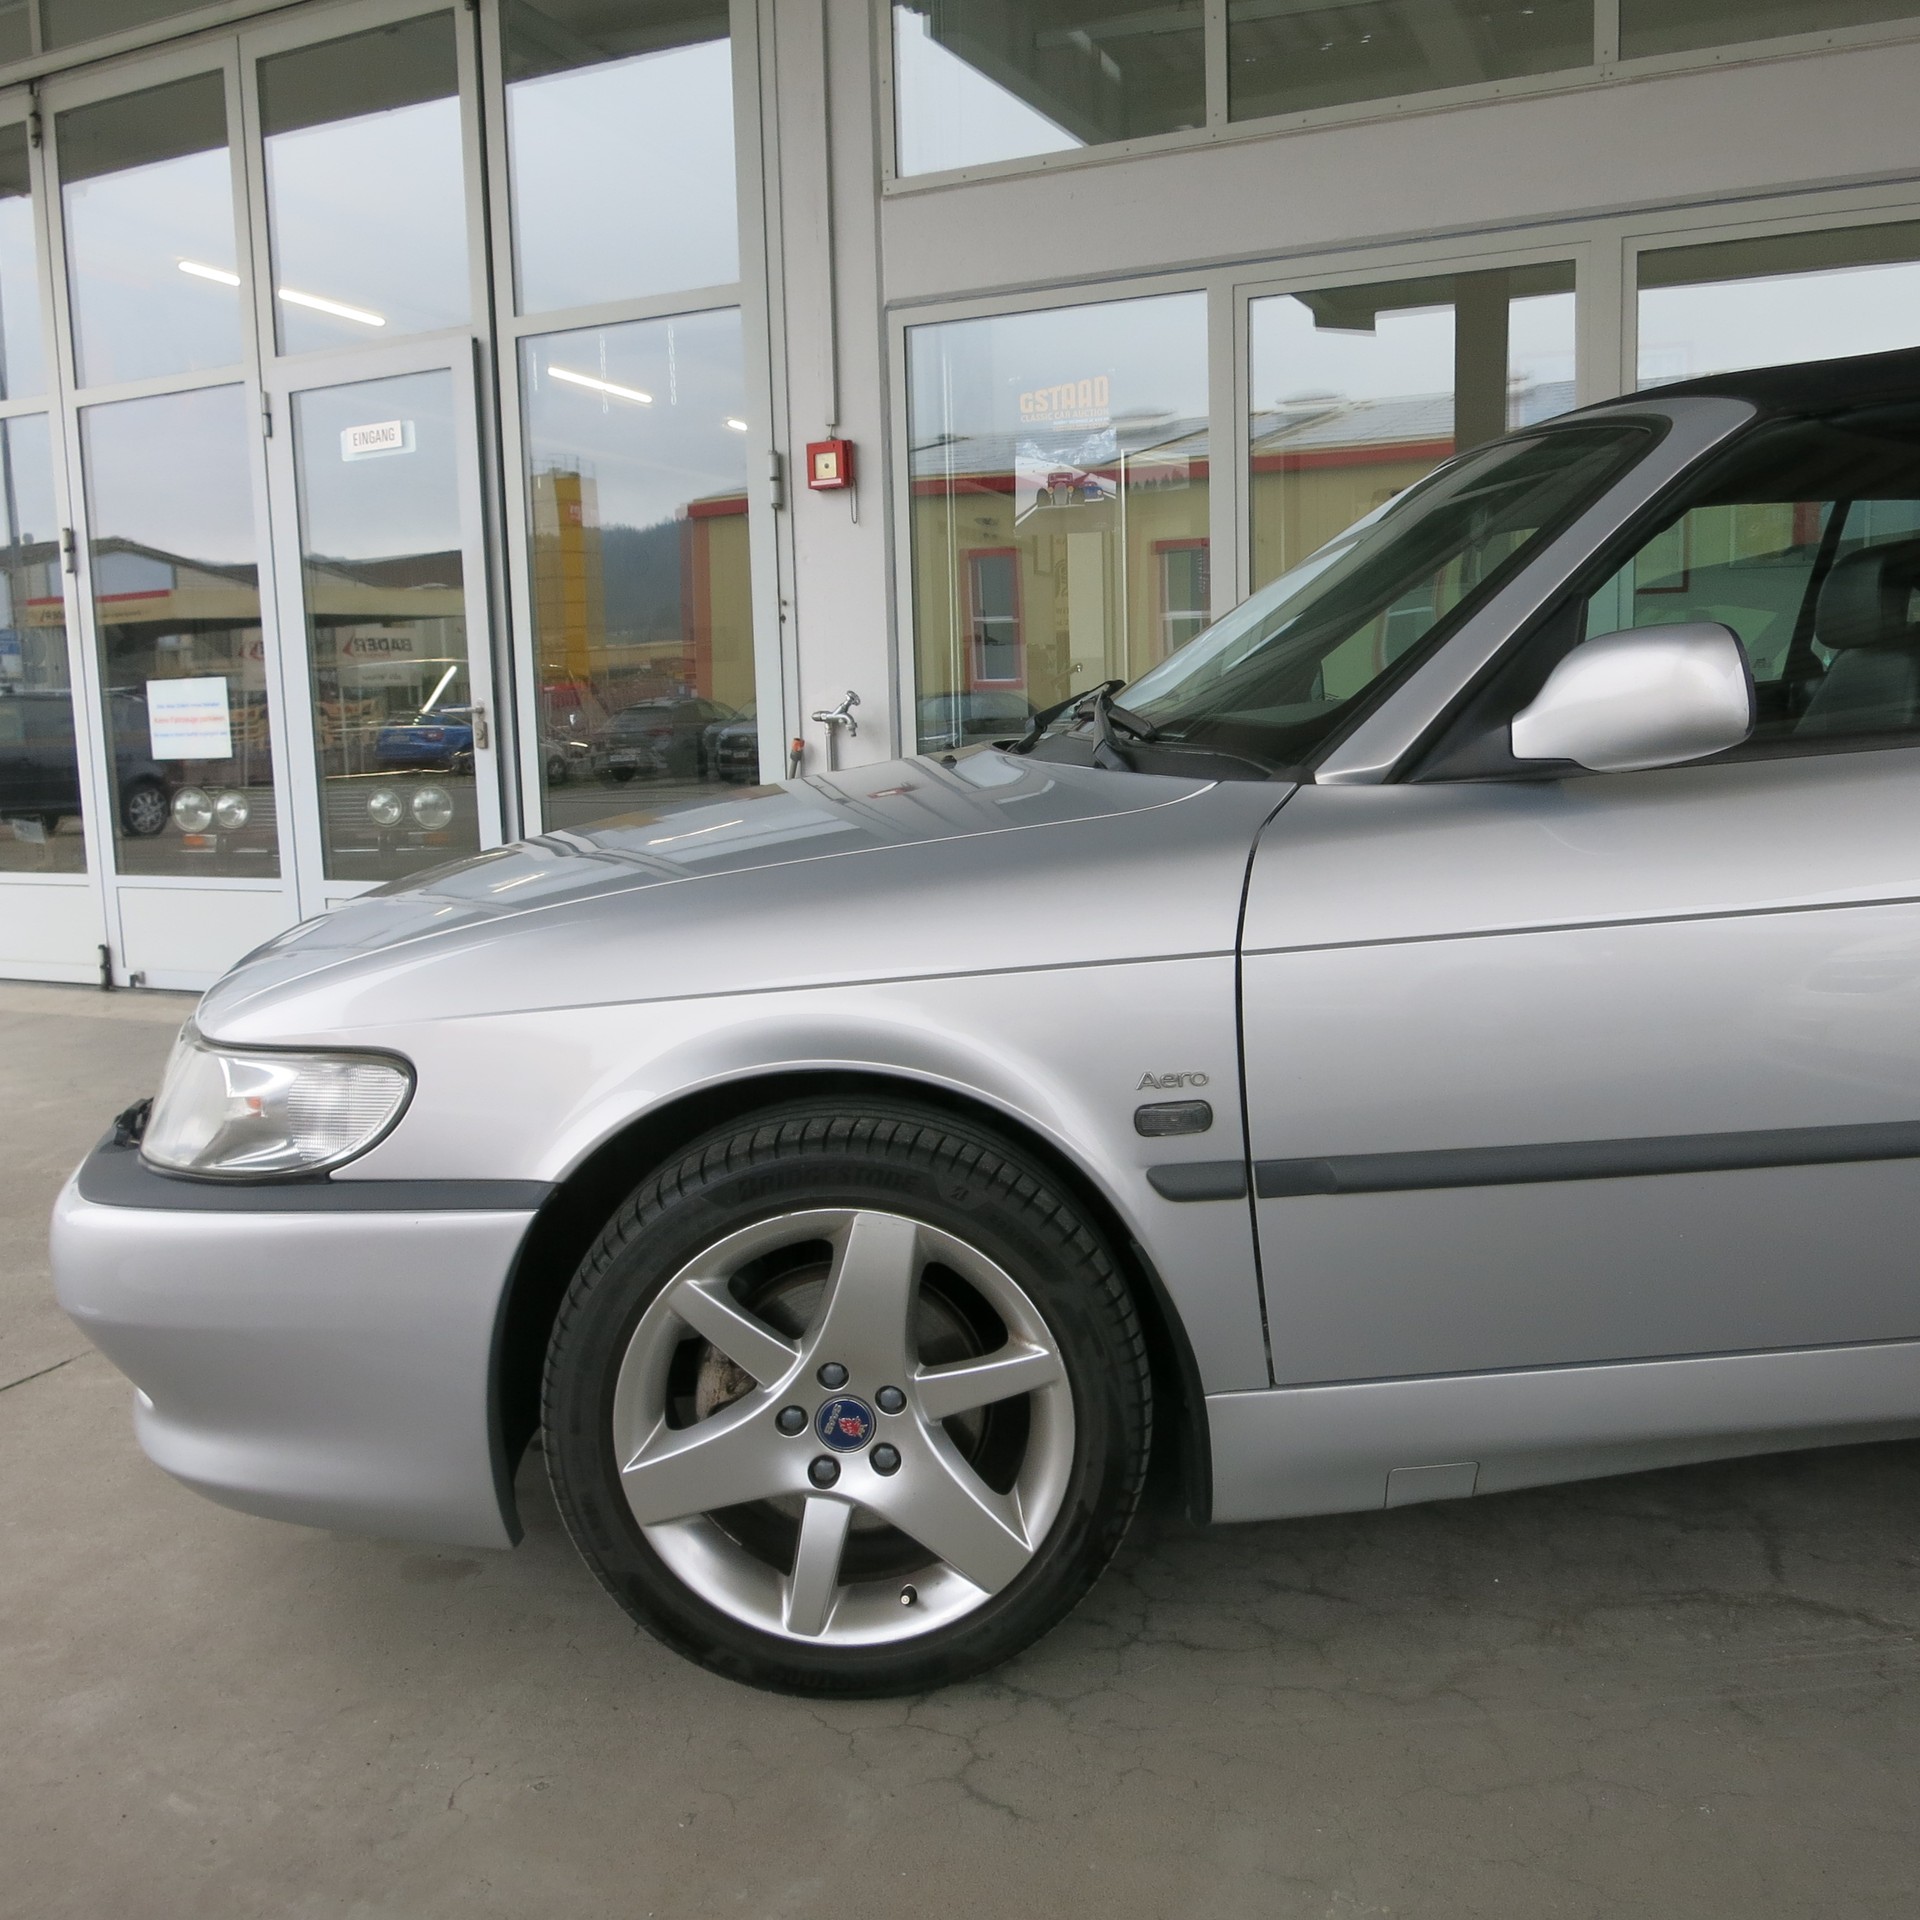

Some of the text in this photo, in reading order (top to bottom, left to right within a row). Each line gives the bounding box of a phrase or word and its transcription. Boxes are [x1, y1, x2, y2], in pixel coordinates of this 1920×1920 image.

[1019, 375, 1109, 414] GSTAAD
[1020, 413, 1053, 423] CLASSIC
[1054, 410, 1071, 420] CAR
[1072, 407, 1110, 418] AUCTION
[352, 427, 395, 446] EINGANG
[1135, 1070, 1210, 1091] Aero
